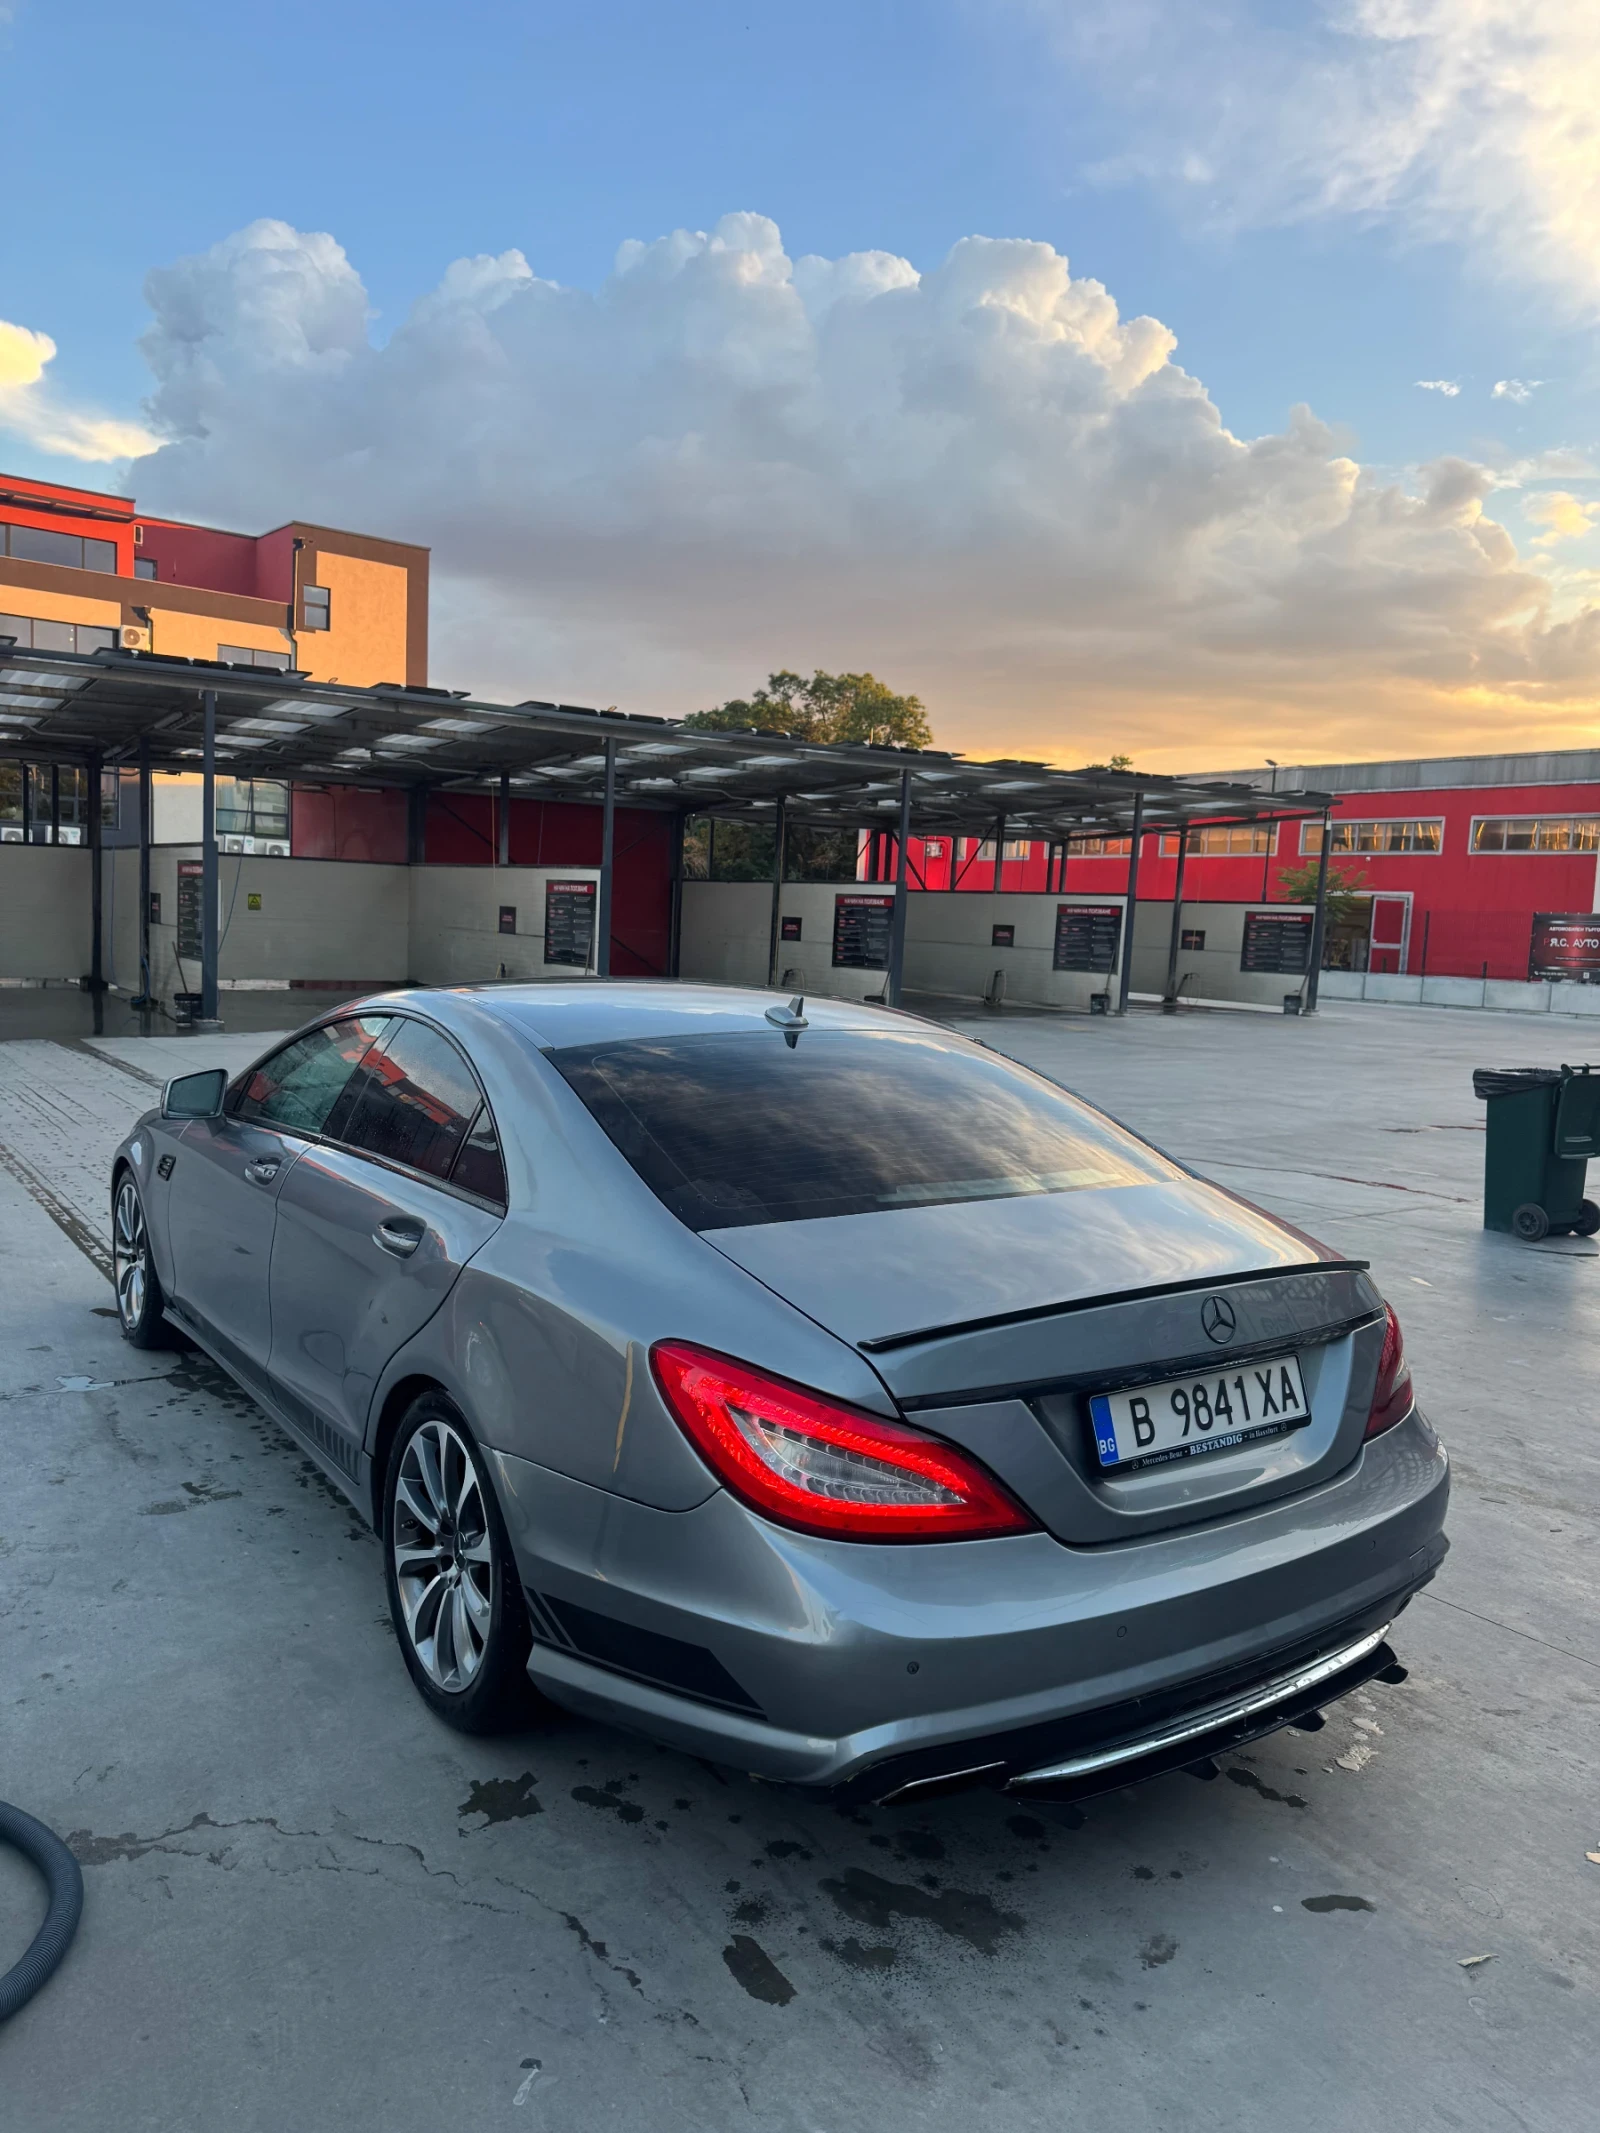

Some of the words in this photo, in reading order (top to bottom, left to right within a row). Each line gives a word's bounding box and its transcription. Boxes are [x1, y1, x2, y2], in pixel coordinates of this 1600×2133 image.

[1129, 1397, 1155, 1447] B
[1170, 1375, 1251, 1437] 9841
[1255, 1366, 1300, 1417] XA
[1099, 1438, 1116, 1455] BG
[1142, 1450, 1183, 1468] Mercedes-Benz
